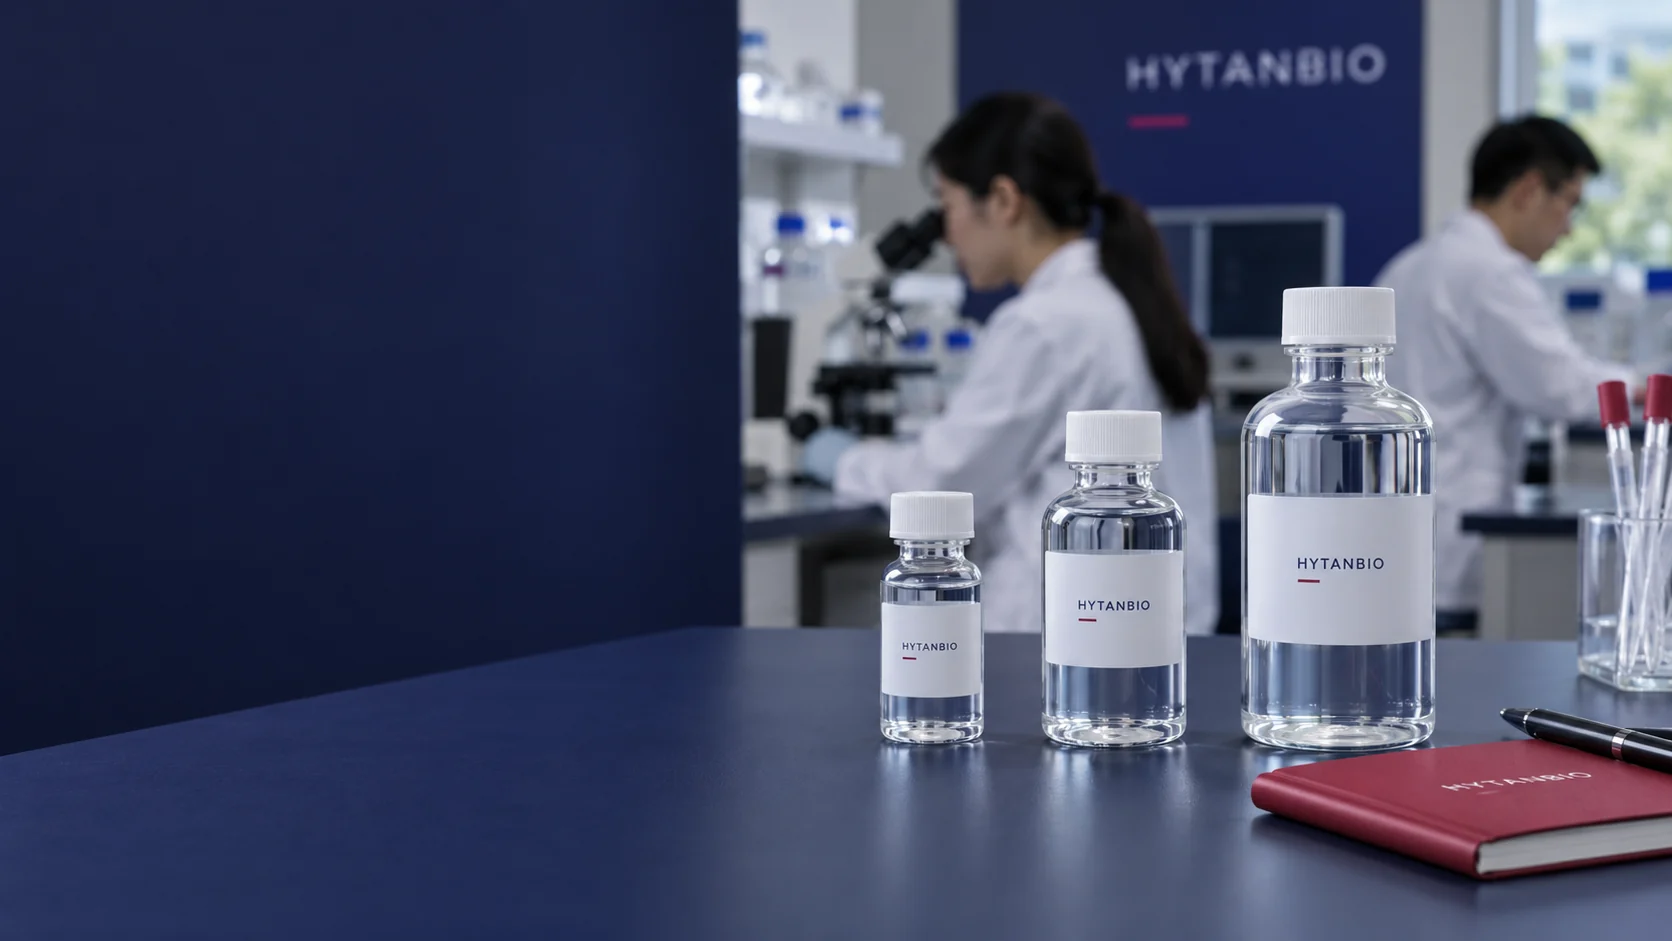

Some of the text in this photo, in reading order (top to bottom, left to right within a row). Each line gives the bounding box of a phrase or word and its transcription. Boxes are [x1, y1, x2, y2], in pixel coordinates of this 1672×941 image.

[1127, 44, 1385, 90] HYTANBIO
[1298, 557, 1384, 570] HYTANBIO
[1078, 600, 1150, 611] HYTANBIO
[902, 642, 958, 651] HYTANBIO
[1441, 772, 1592, 792] HYTANBIO
